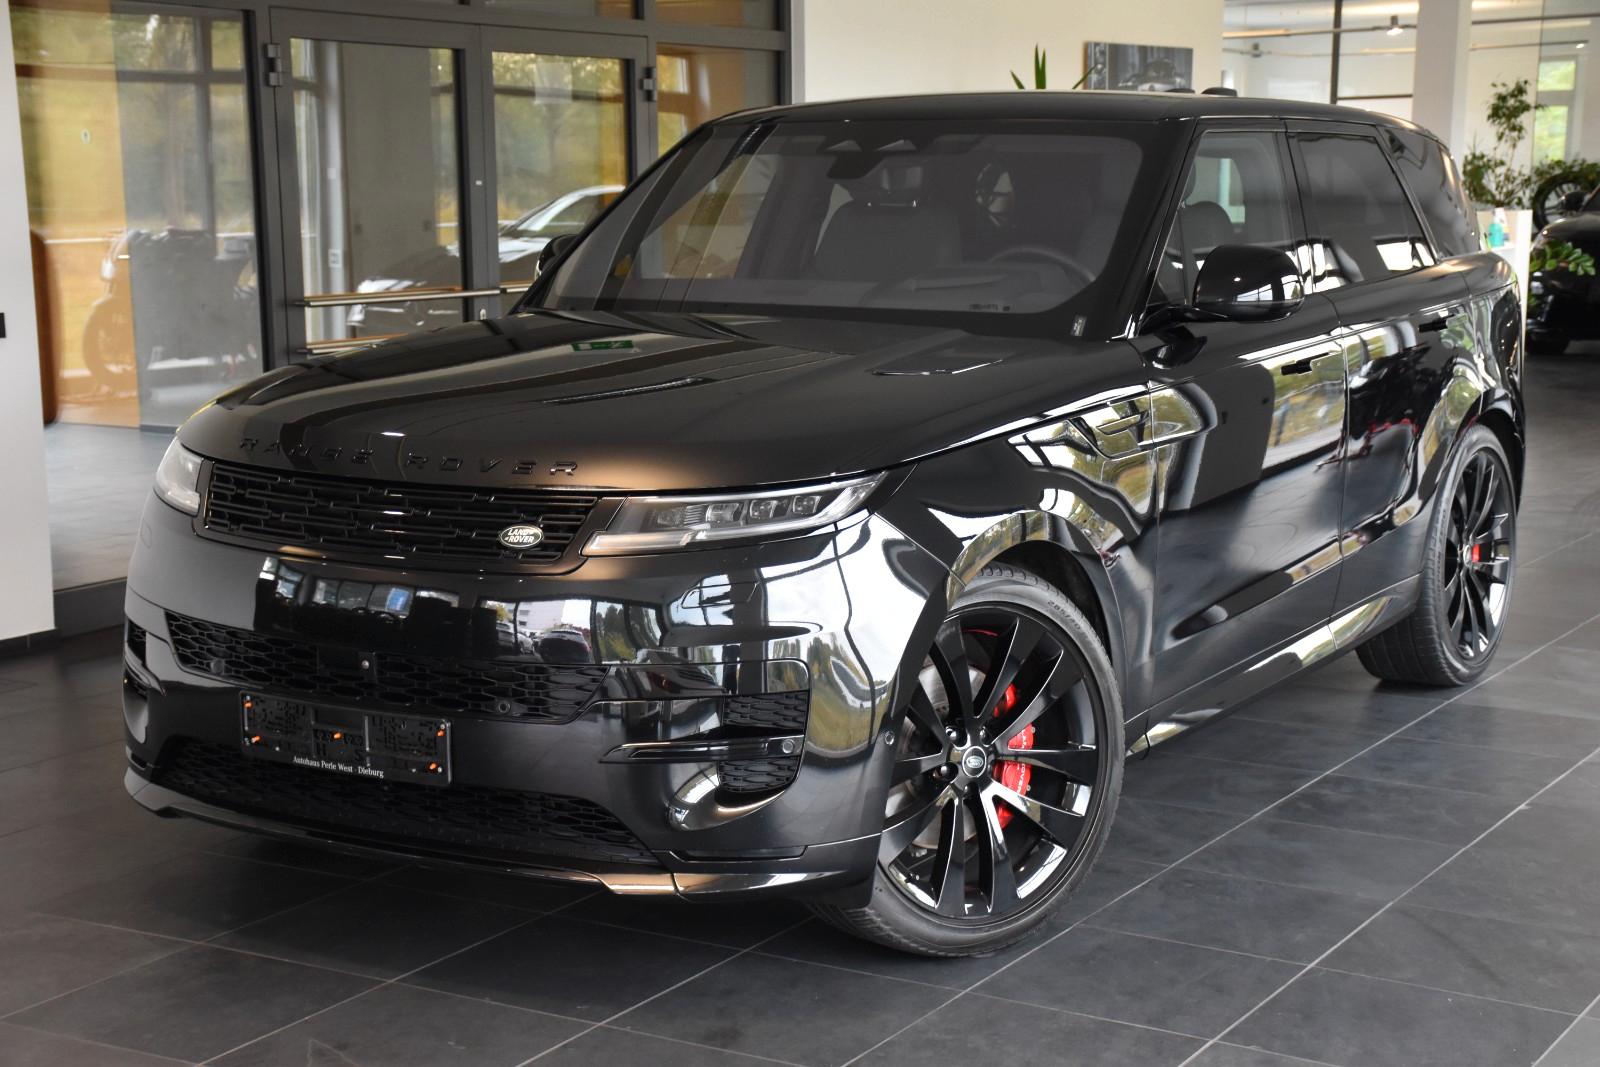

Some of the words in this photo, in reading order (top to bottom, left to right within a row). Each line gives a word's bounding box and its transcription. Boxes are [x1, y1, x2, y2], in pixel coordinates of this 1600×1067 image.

[240, 438, 375, 465] RANGE
[405, 453, 578, 477] ROVER
[507, 528, 529, 536] LAND
[508, 535, 535, 543] ROVER
[293, 755, 320, 768] Autohaus
[321, 760, 337, 771] Perle
[338, 763, 353, 773] West
[358, 766, 384, 779] Dieburg
